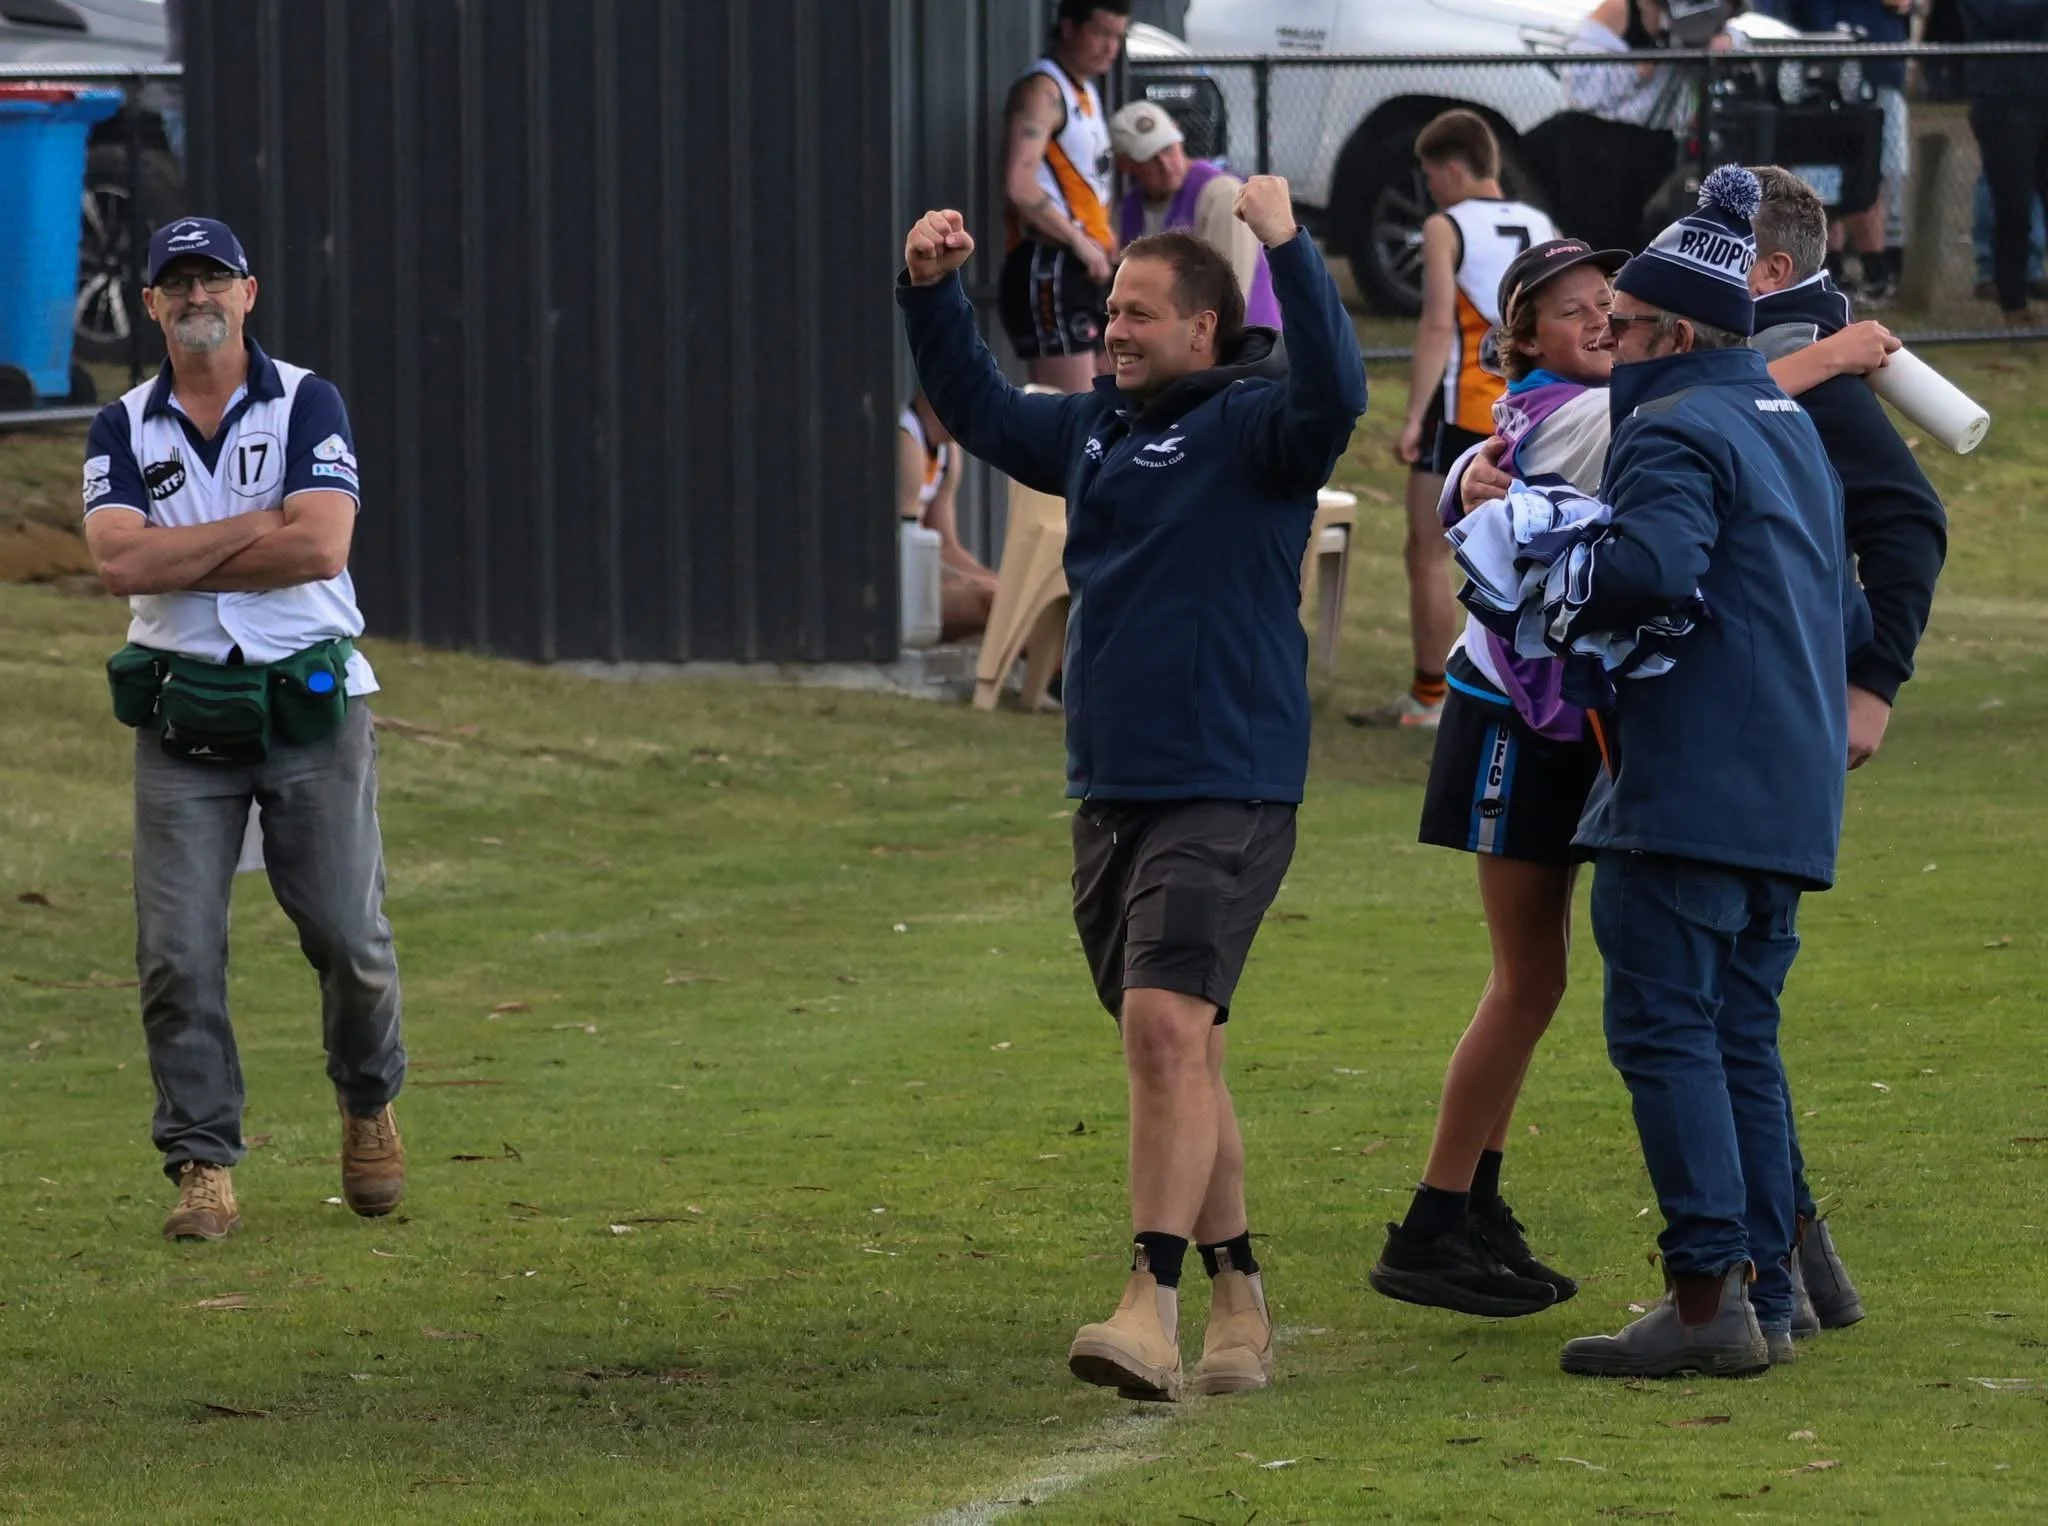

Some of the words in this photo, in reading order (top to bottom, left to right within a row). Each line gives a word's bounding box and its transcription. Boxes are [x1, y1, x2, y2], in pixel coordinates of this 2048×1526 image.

[1494, 225, 1531, 255] 7
[1677, 230, 1755, 275] BRIDPO
[238, 442, 269, 487] 17
[1132, 456, 1168, 468] FOOTBALL
[1168, 451, 1186, 465] CLUB
[152, 468, 186, 498] NTFA
